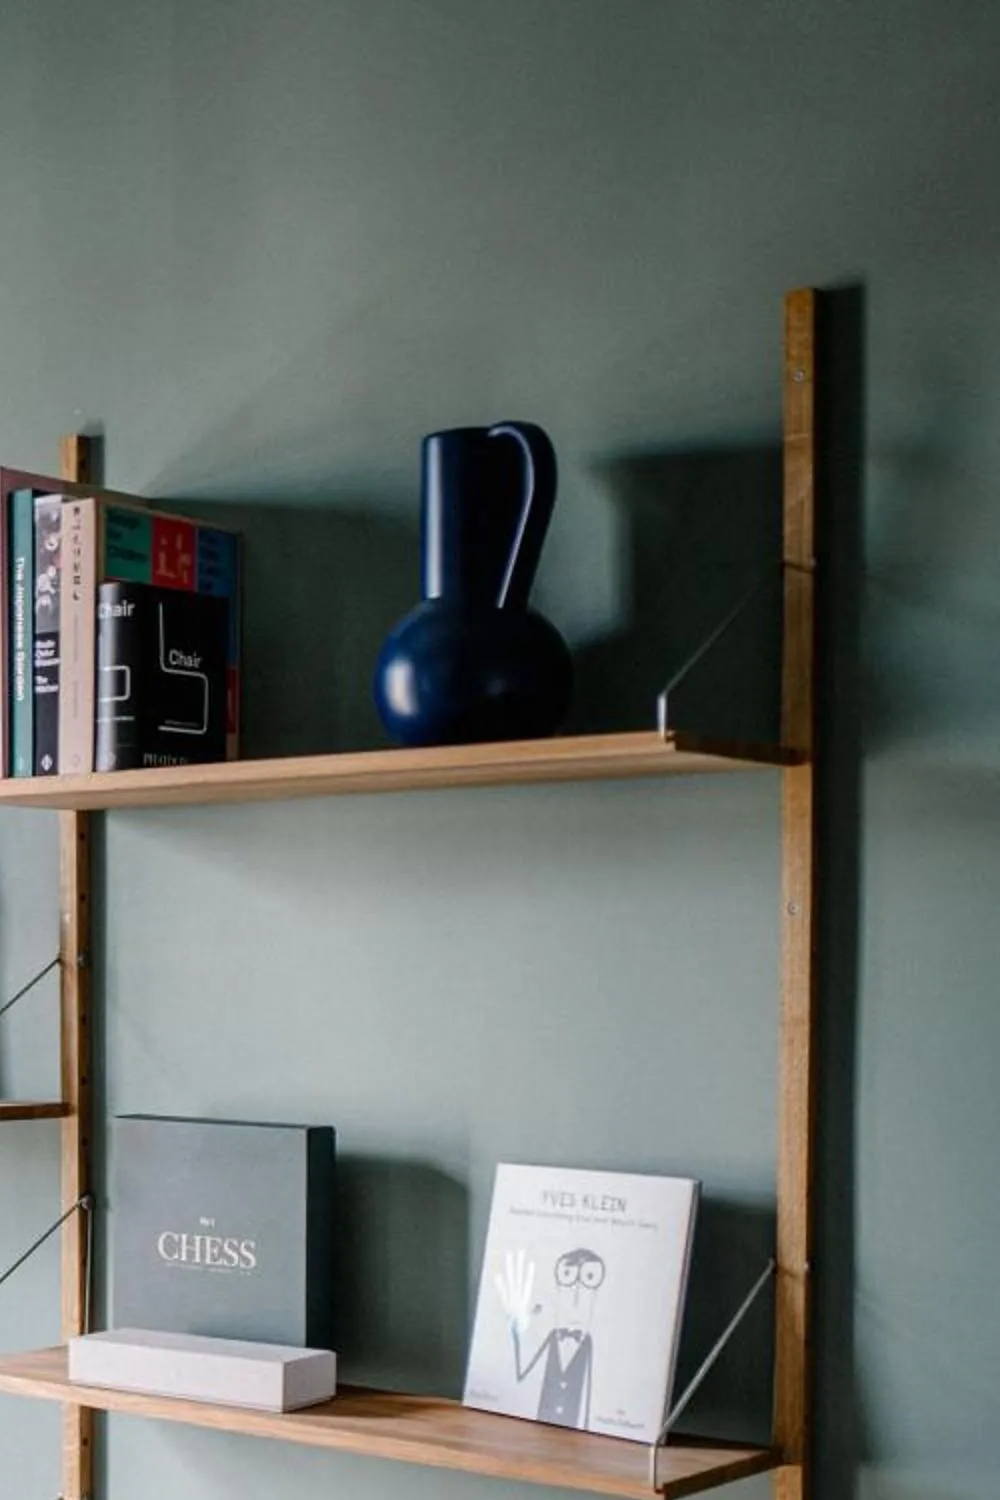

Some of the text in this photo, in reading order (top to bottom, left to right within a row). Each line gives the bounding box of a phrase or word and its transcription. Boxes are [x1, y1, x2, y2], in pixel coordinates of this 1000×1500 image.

[14, 583, 25, 649] Japanese
[169, 649, 203, 668] Chair
[158, 1230, 256, 1270] CHESS
